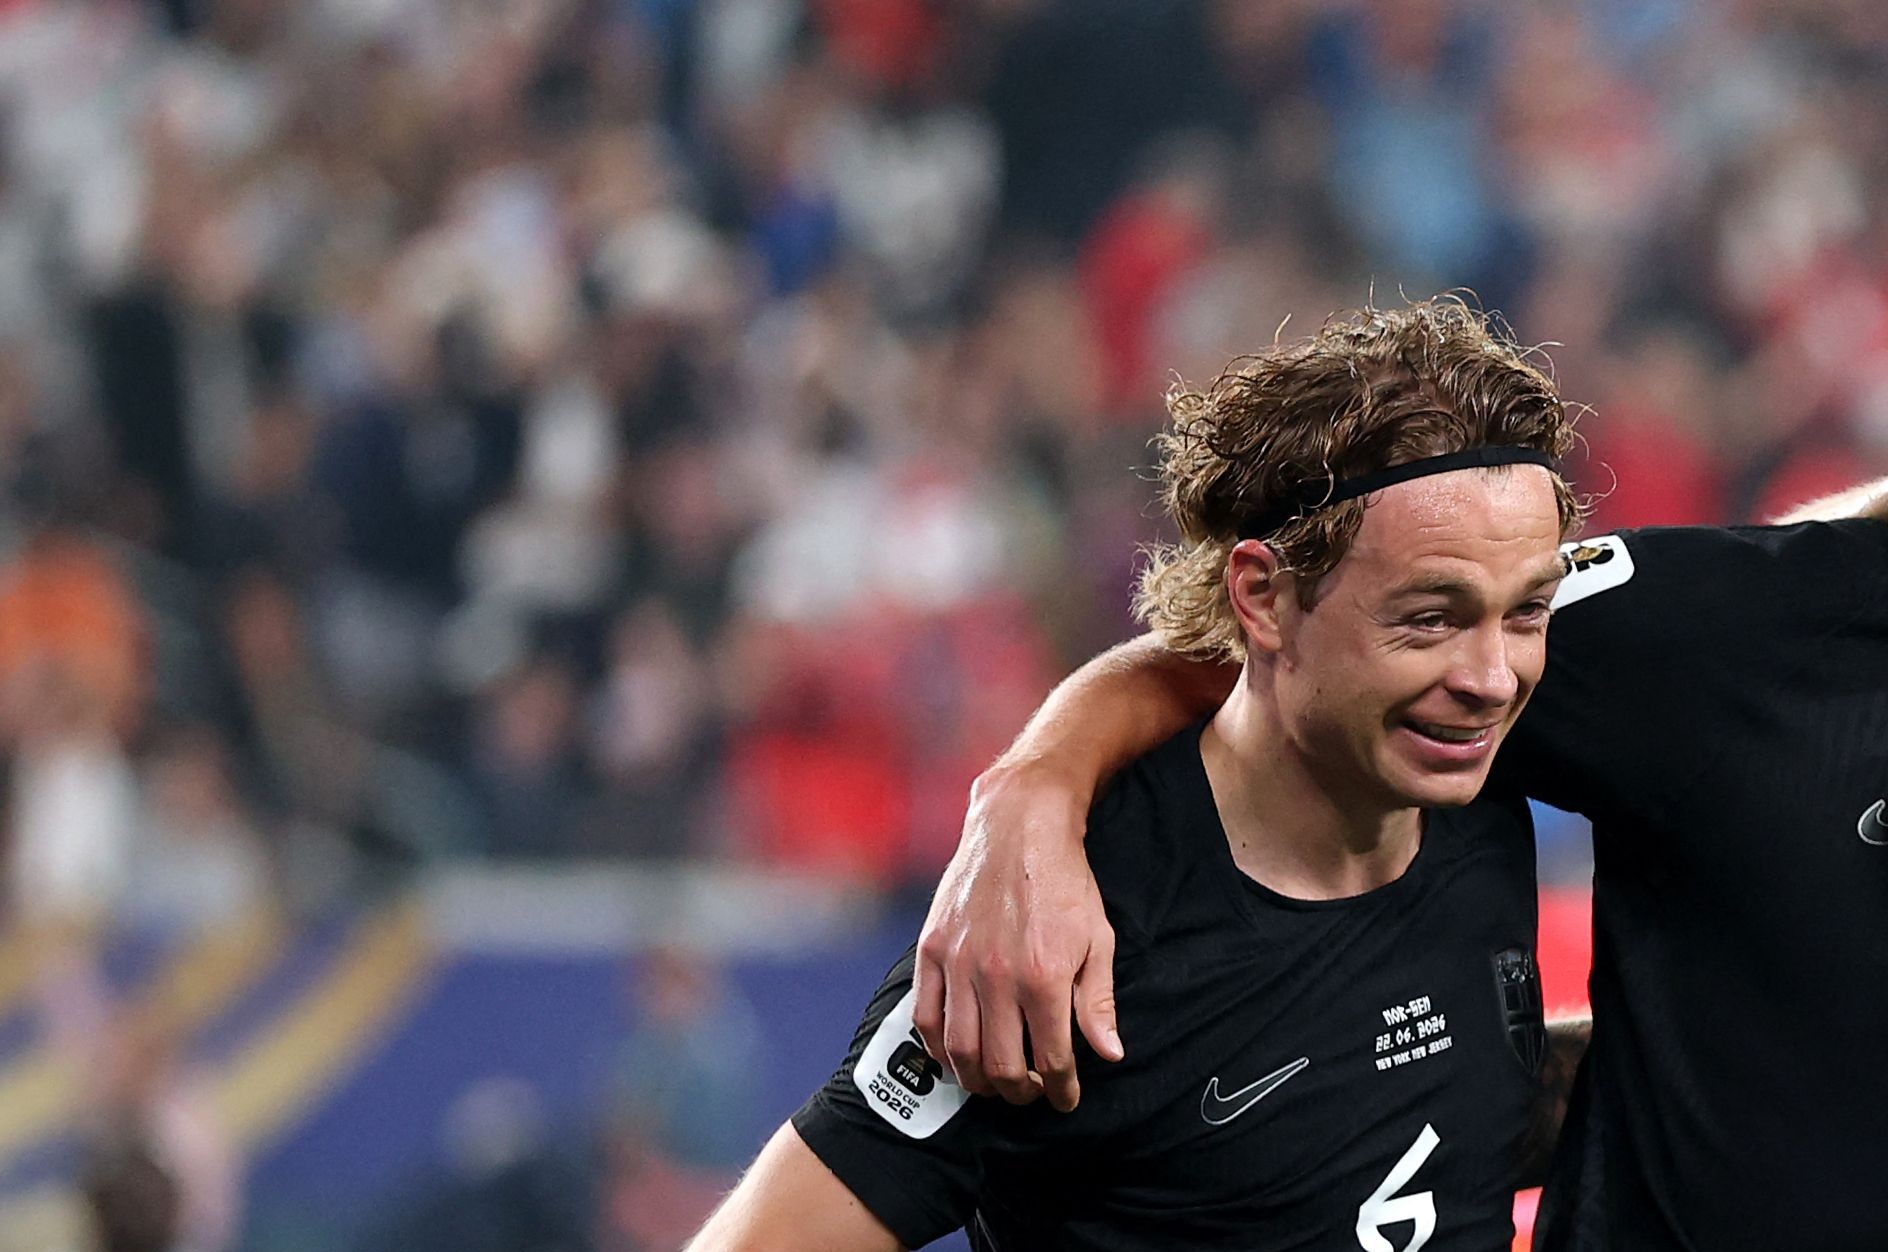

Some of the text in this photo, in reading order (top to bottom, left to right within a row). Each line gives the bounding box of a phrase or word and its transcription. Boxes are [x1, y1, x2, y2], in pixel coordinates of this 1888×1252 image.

[1382, 995, 1431, 1026] NOR-SEN
[876, 1070, 921, 1109] WORLD CUP
[896, 1064, 920, 1087] FIFA
[868, 1079, 914, 1121] 2026
